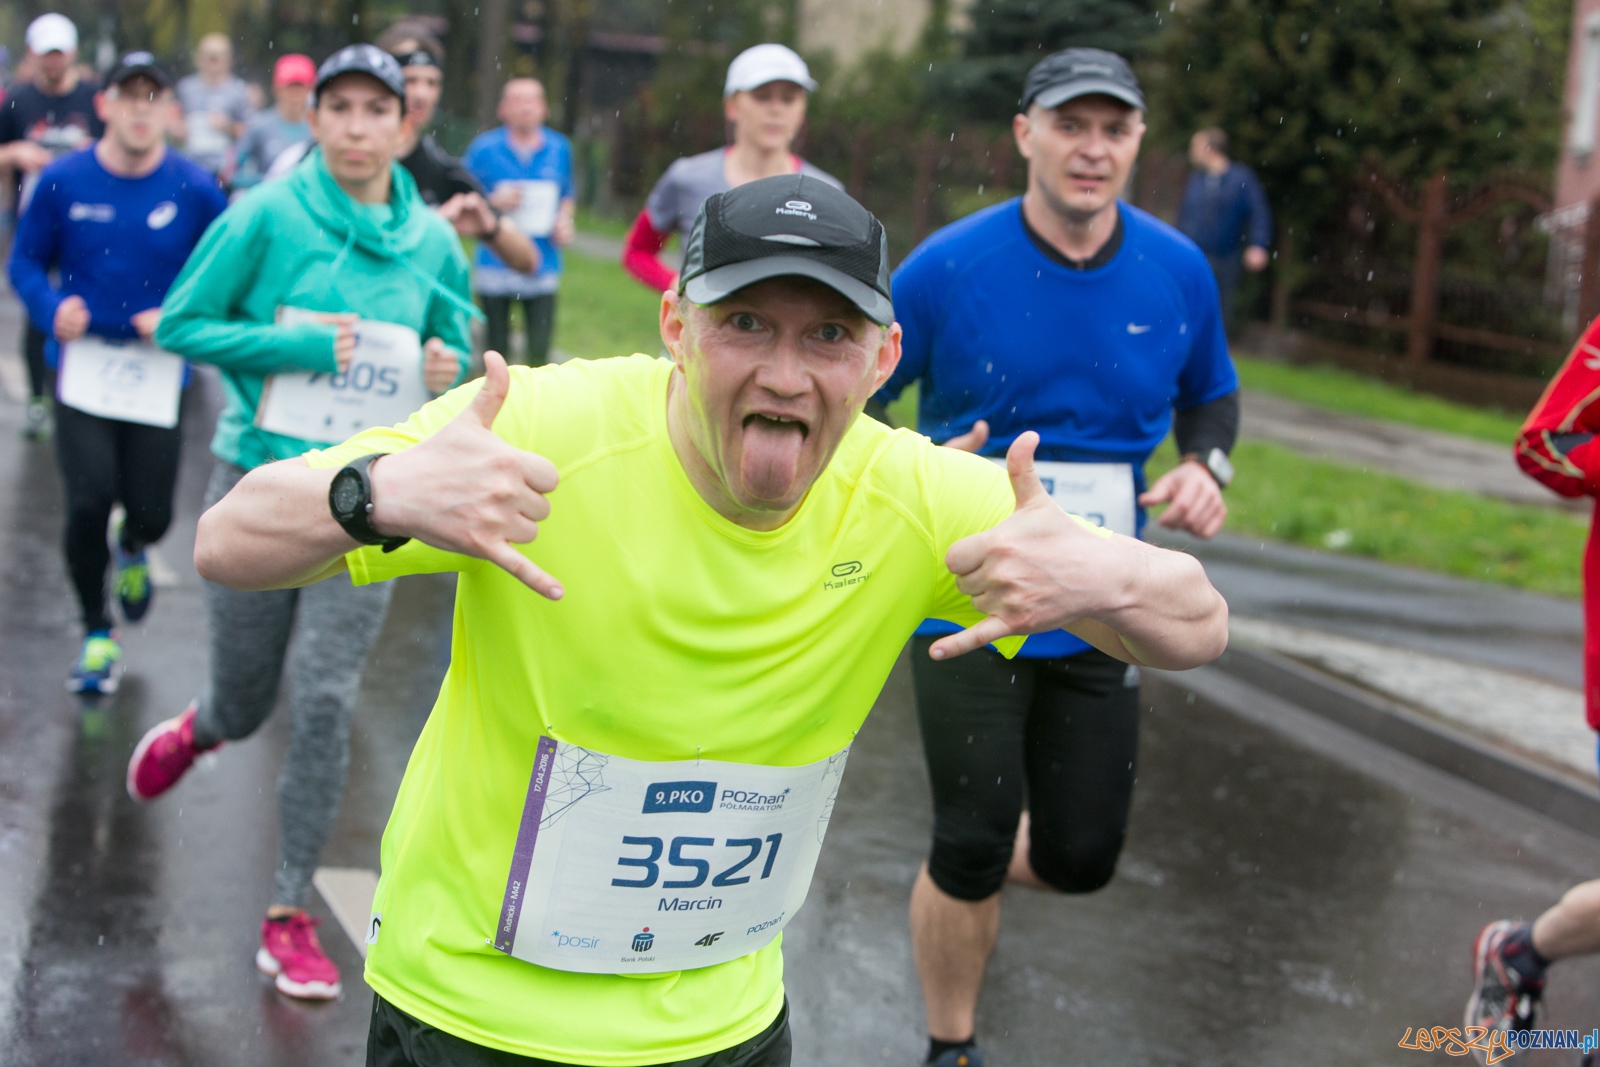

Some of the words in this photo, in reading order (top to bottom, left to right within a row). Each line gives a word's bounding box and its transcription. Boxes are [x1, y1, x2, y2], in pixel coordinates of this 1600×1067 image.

[775, 207, 817, 220] Kalenji
[533, 753, 550, 793] 17.04.2016
[655, 790, 667, 805] 9.
[669, 790, 704, 804] PKO
[720, 802, 783, 811] PÓŁMARATON
[611, 832, 783, 889] 3521
[503, 904, 516, 933] Rudnicki
[510, 880, 521, 900] M42
[657, 896, 723, 912] Marcin
